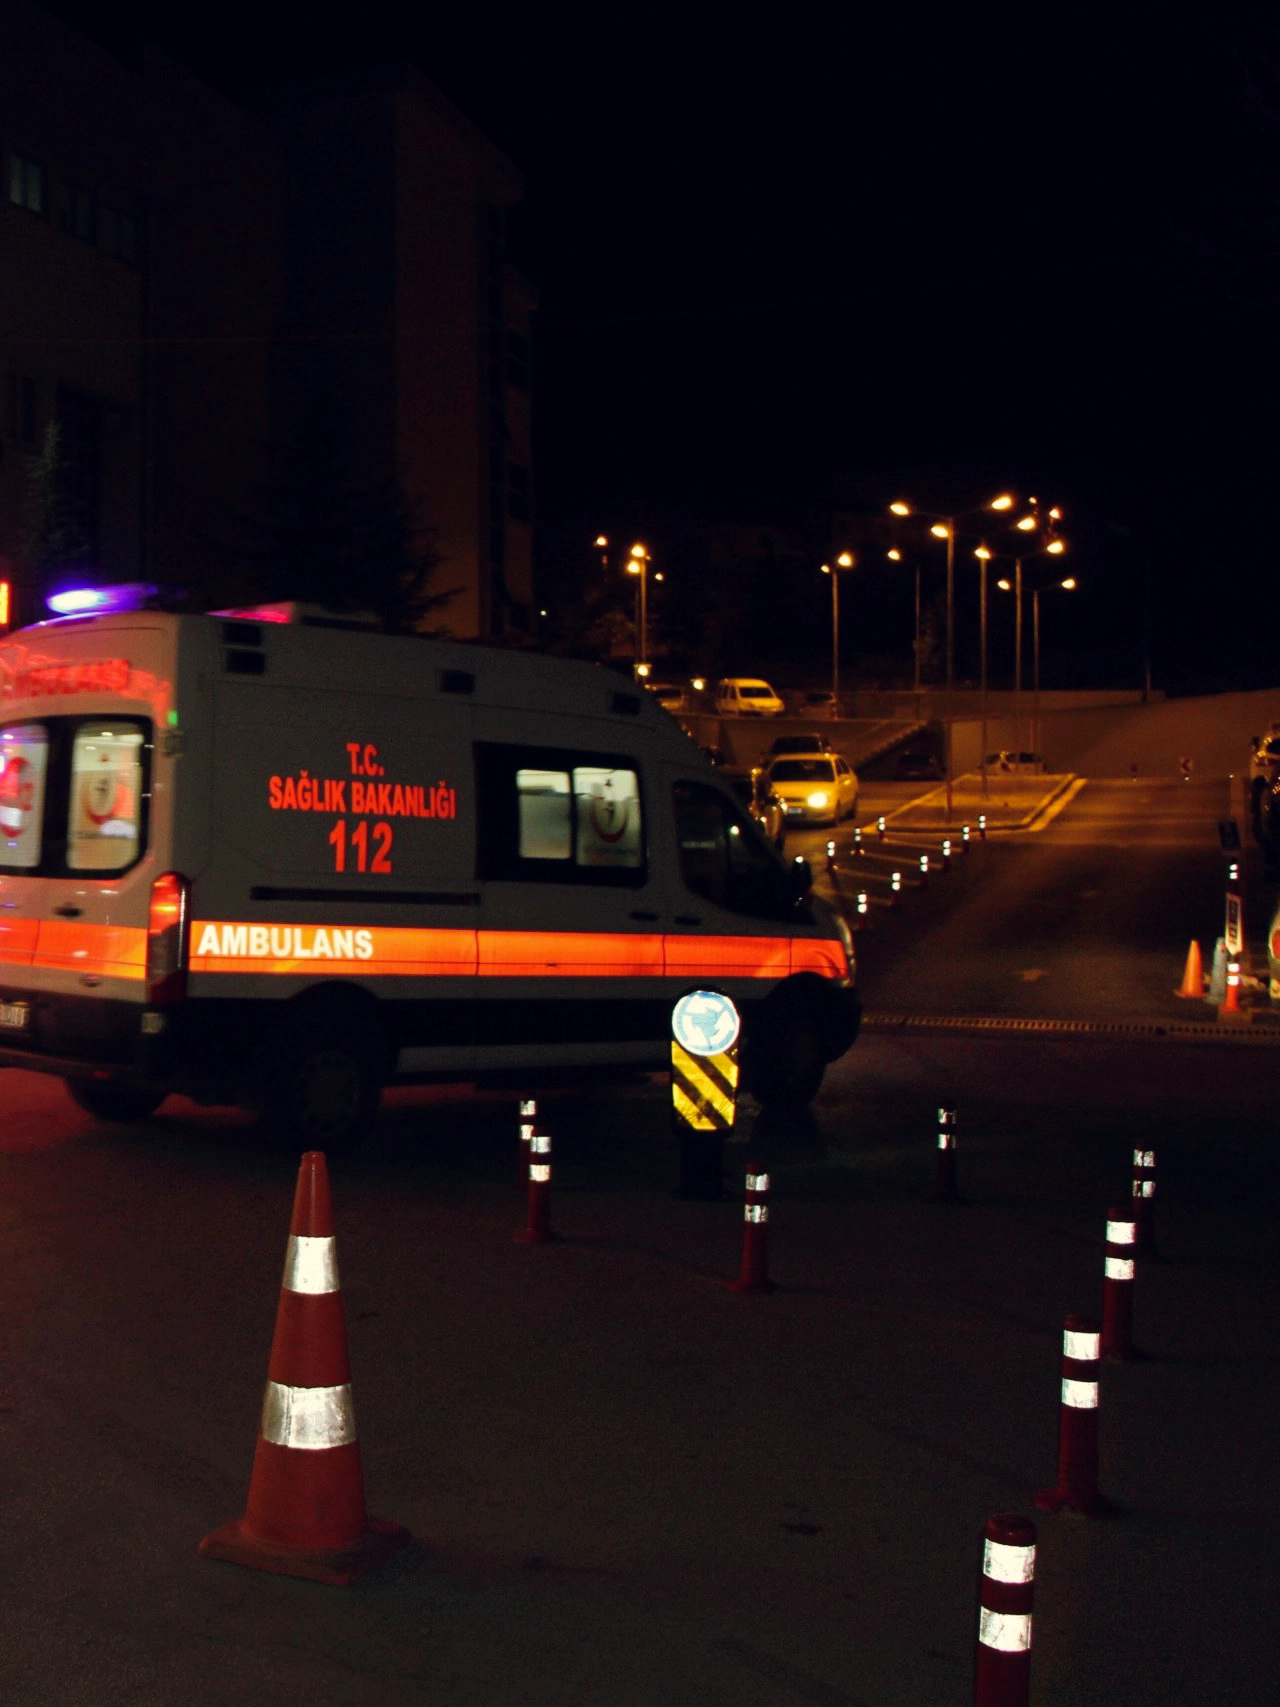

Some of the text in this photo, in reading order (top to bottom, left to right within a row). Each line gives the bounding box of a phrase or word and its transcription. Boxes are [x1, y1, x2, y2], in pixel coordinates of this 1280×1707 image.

[346, 742, 385, 777] T.C.
[268, 769, 457, 820] SAĞLIK BAKANLIĞI
[328, 819, 394, 874] 112
[197, 923, 375, 960] AMBULANS
